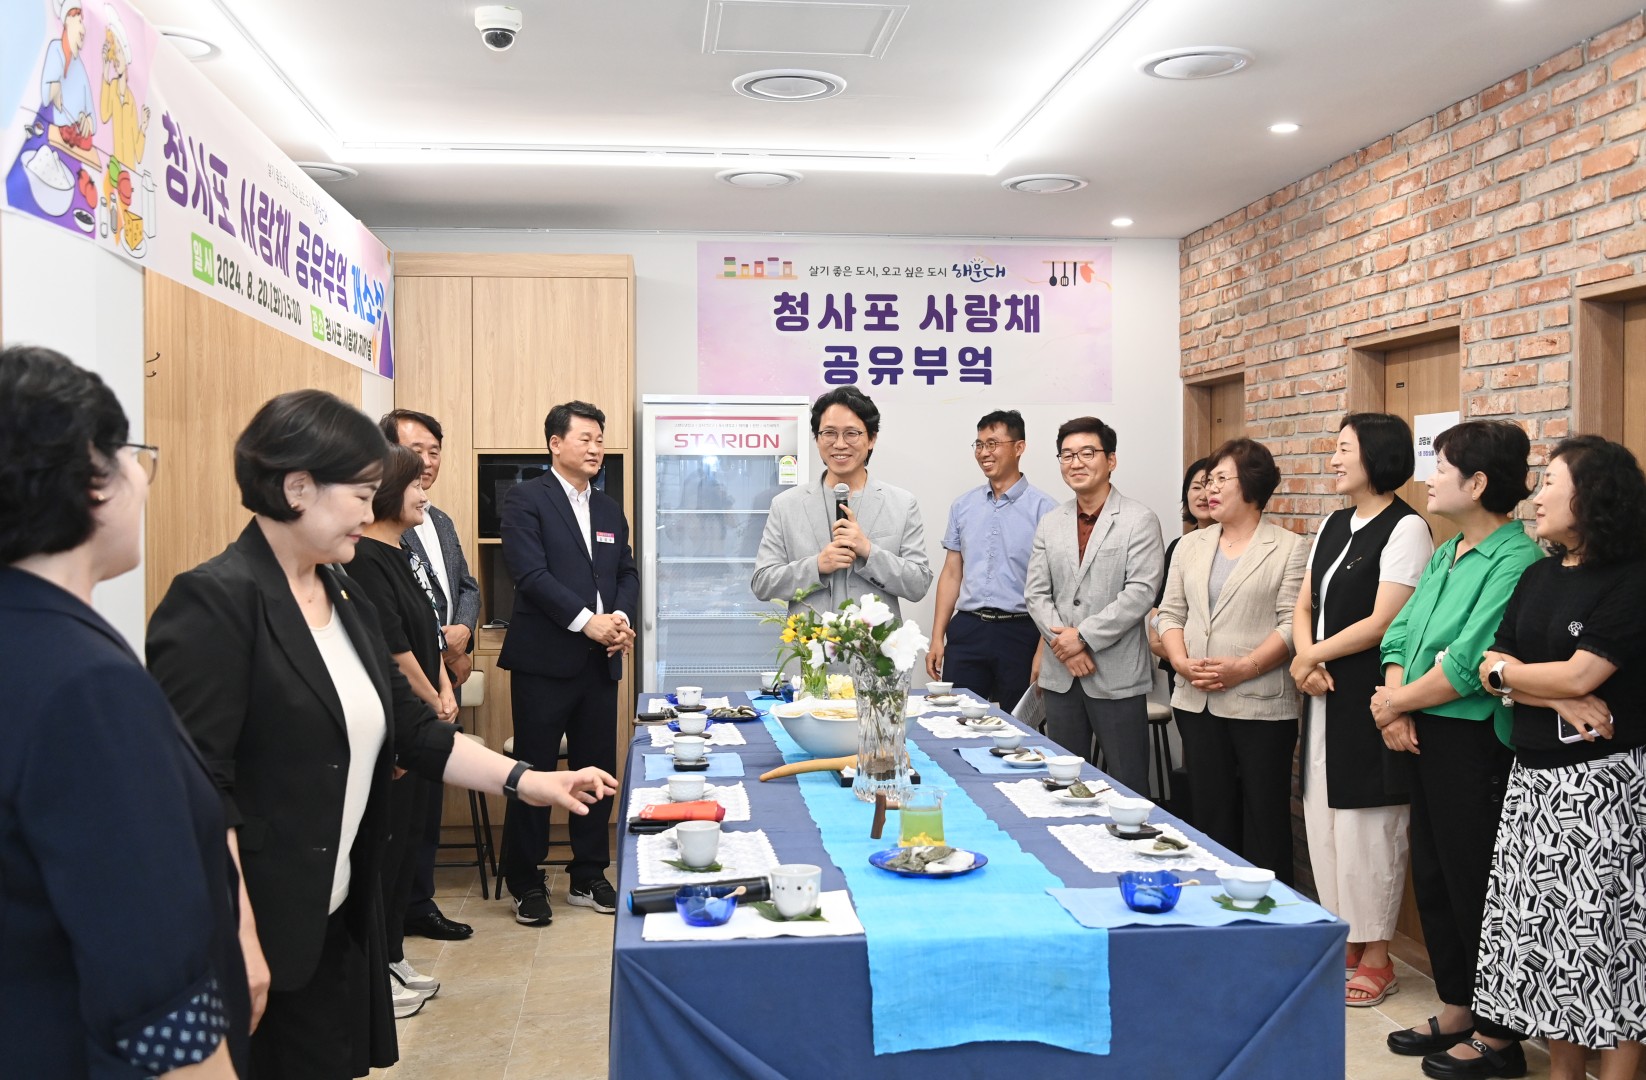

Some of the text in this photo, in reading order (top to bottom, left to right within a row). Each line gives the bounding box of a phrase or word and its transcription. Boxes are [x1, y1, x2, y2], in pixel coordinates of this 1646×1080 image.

[162, 110, 384, 332] 청사포 사랑채 공유부엌 개소식
[193, 239, 213, 279] 일시
[217, 253, 243, 297] 2024.
[247, 270, 256, 302] 8.
[808, 261, 1006, 282] 살기 좋은 도시, 오고 싶은 도시 해운대
[325, 316, 342, 347] 청사포
[773, 291, 1040, 333] 청사포 사랑채
[823, 345, 992, 385] 공유부엌
[674, 433, 780, 449] STARION
